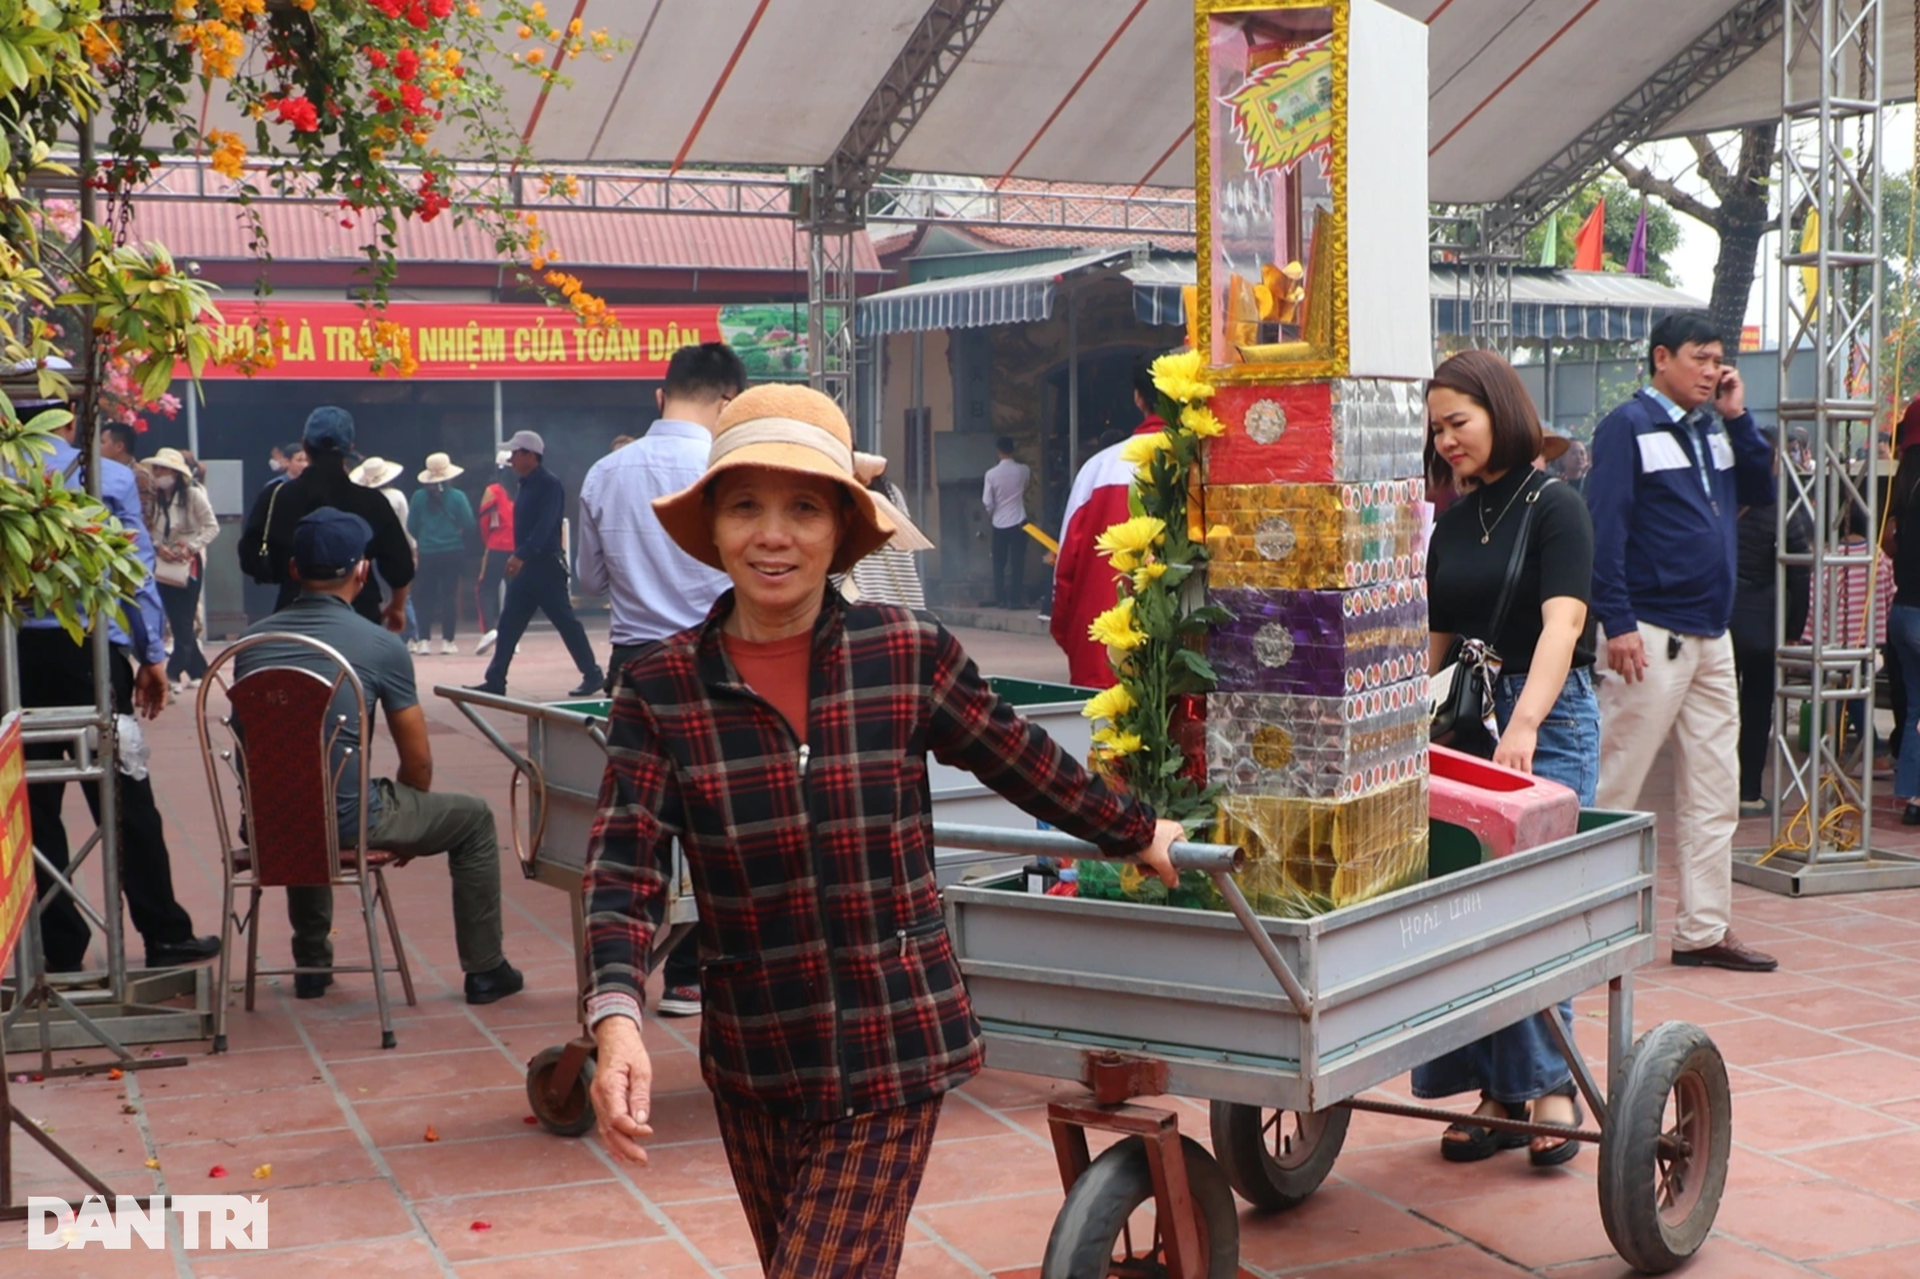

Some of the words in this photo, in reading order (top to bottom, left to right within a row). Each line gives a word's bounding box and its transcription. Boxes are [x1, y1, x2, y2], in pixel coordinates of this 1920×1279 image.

[282, 318, 315, 361] LÀ
[322, 319, 410, 361] TRÁH
[419, 320, 505, 370] NHIỆM
[514, 316, 566, 361] CỦA
[648, 321, 699, 361] DÂN
